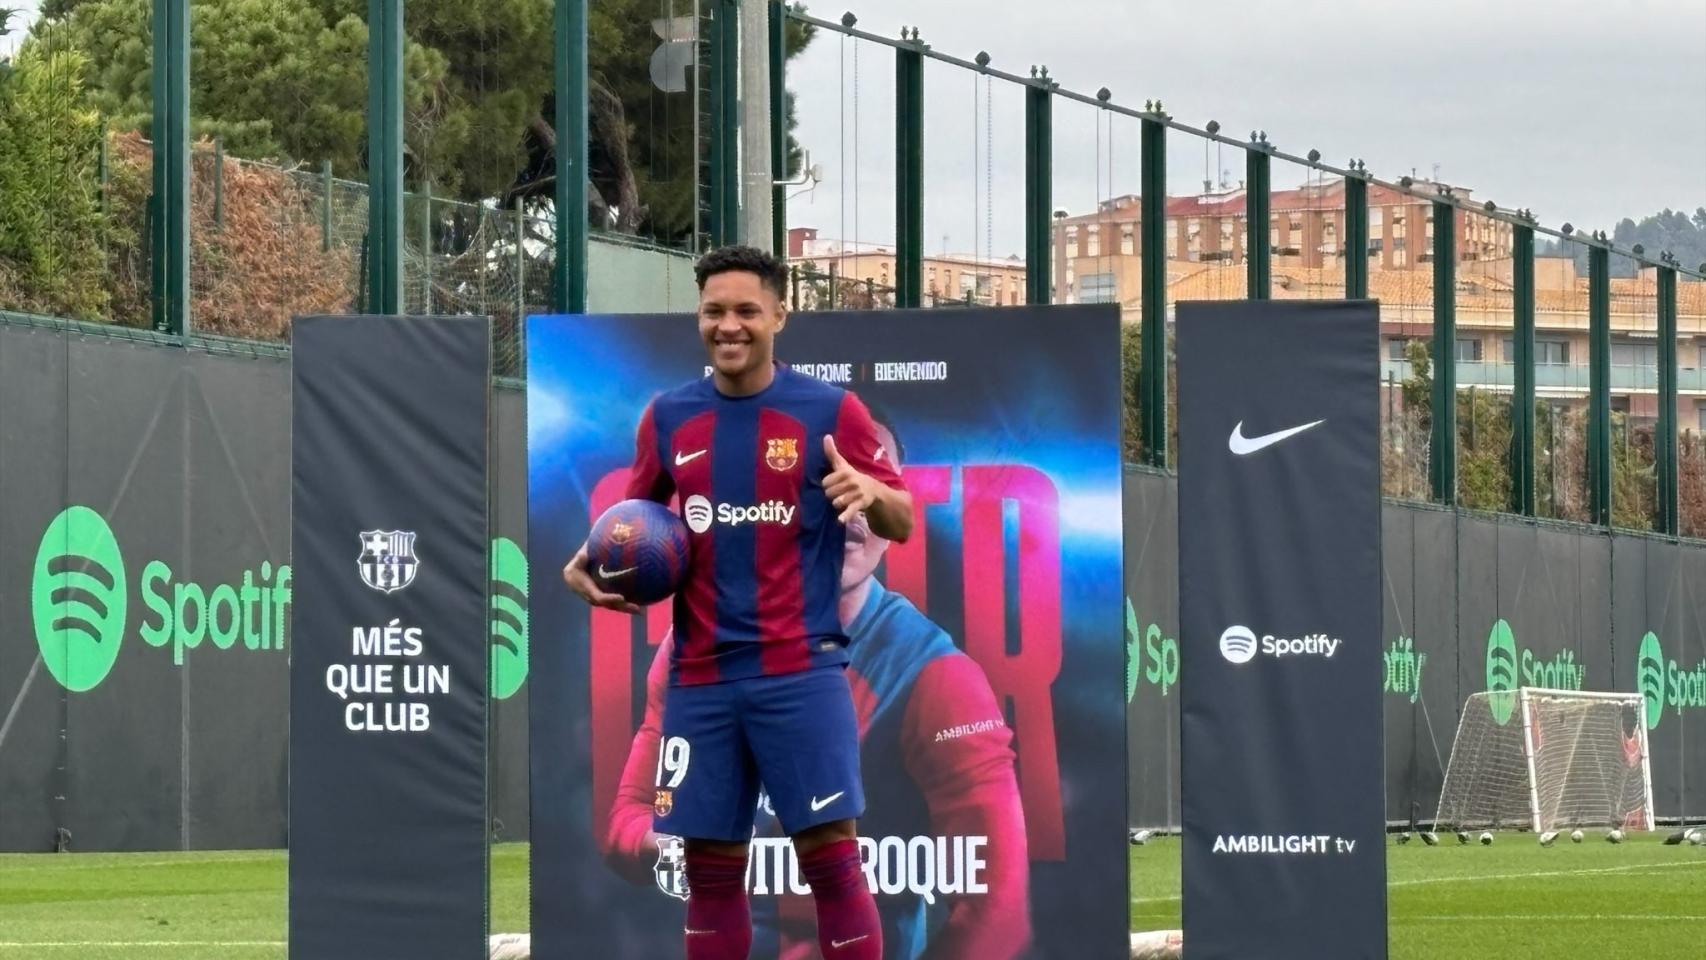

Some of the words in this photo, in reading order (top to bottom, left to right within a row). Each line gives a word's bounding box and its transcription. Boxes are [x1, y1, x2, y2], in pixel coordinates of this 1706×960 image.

[874, 361, 947, 381] BIENVENIDO
[717, 500, 795, 526] Spotify
[139, 560, 292, 666] Spotif
[352, 618, 423, 656] MÉS
[1262, 634, 1338, 658] Spotify
[326, 664, 393, 699] QUE
[403, 665, 450, 694] UN
[1668, 659, 1706, 715] Spoti
[345, 702, 430, 732] CLUB
[1212, 834, 1330, 853] AMBILIGHT
[1336, 837, 1356, 853] tv
[858, 835, 989, 905] ROQUE
